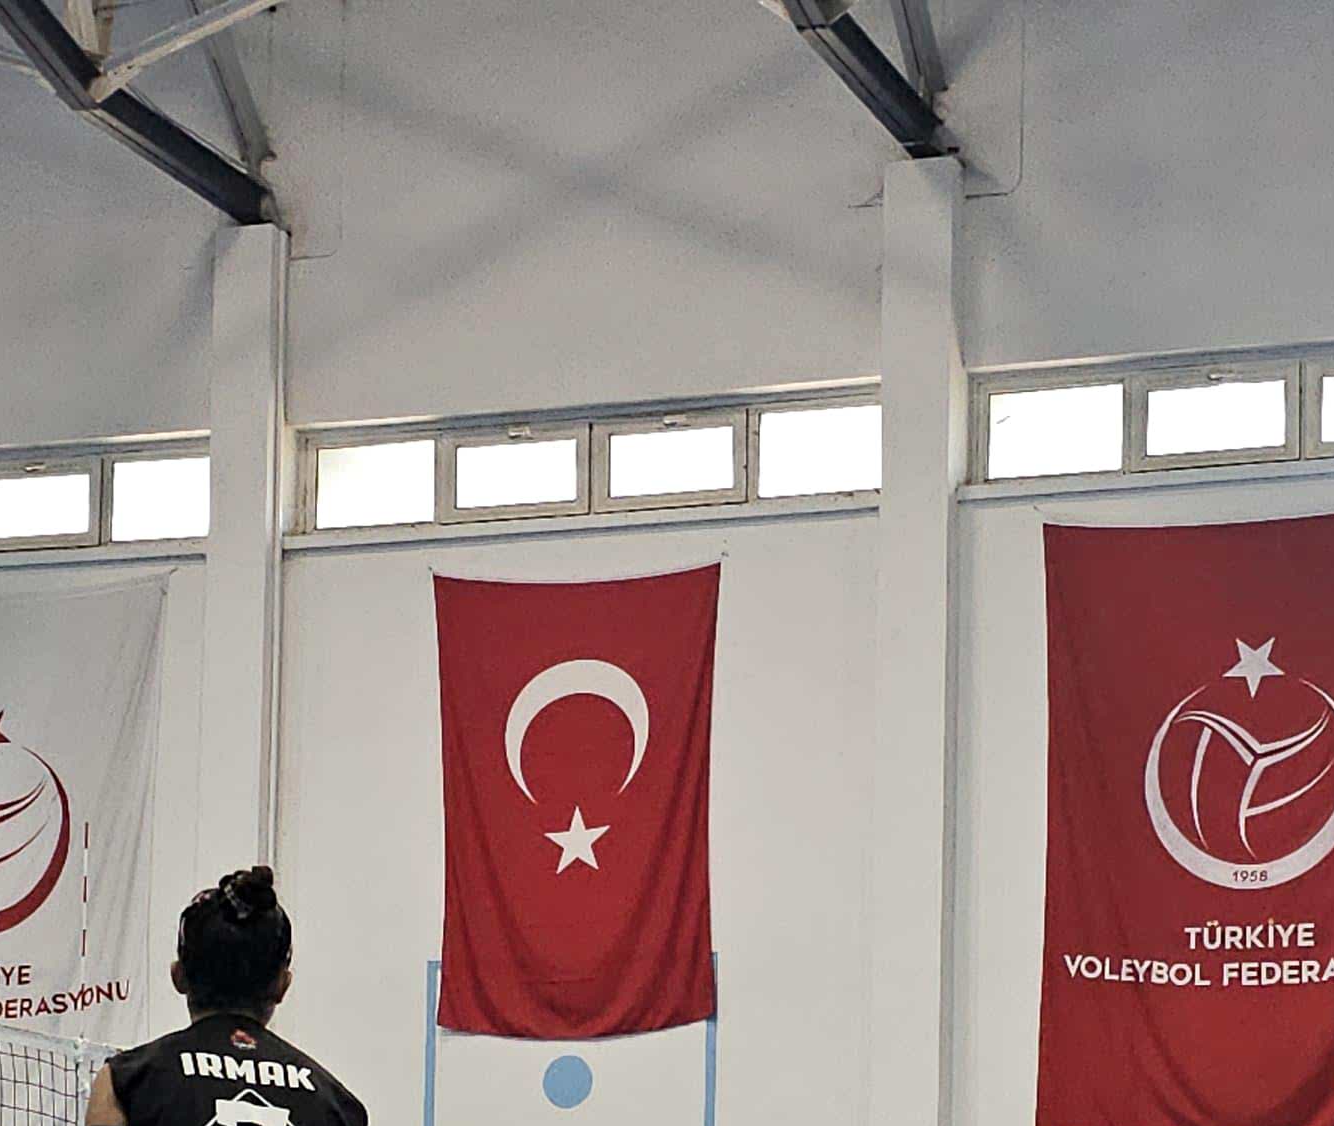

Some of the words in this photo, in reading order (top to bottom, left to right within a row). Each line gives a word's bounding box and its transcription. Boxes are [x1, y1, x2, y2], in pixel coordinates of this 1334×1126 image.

[1231, 869, 1268, 883] 1958
[1184, 918, 1316, 950] TÜRKİYE
[1064, 953, 1212, 986] VOLEYBOL
[180, 1051, 316, 1092] IRMAK
